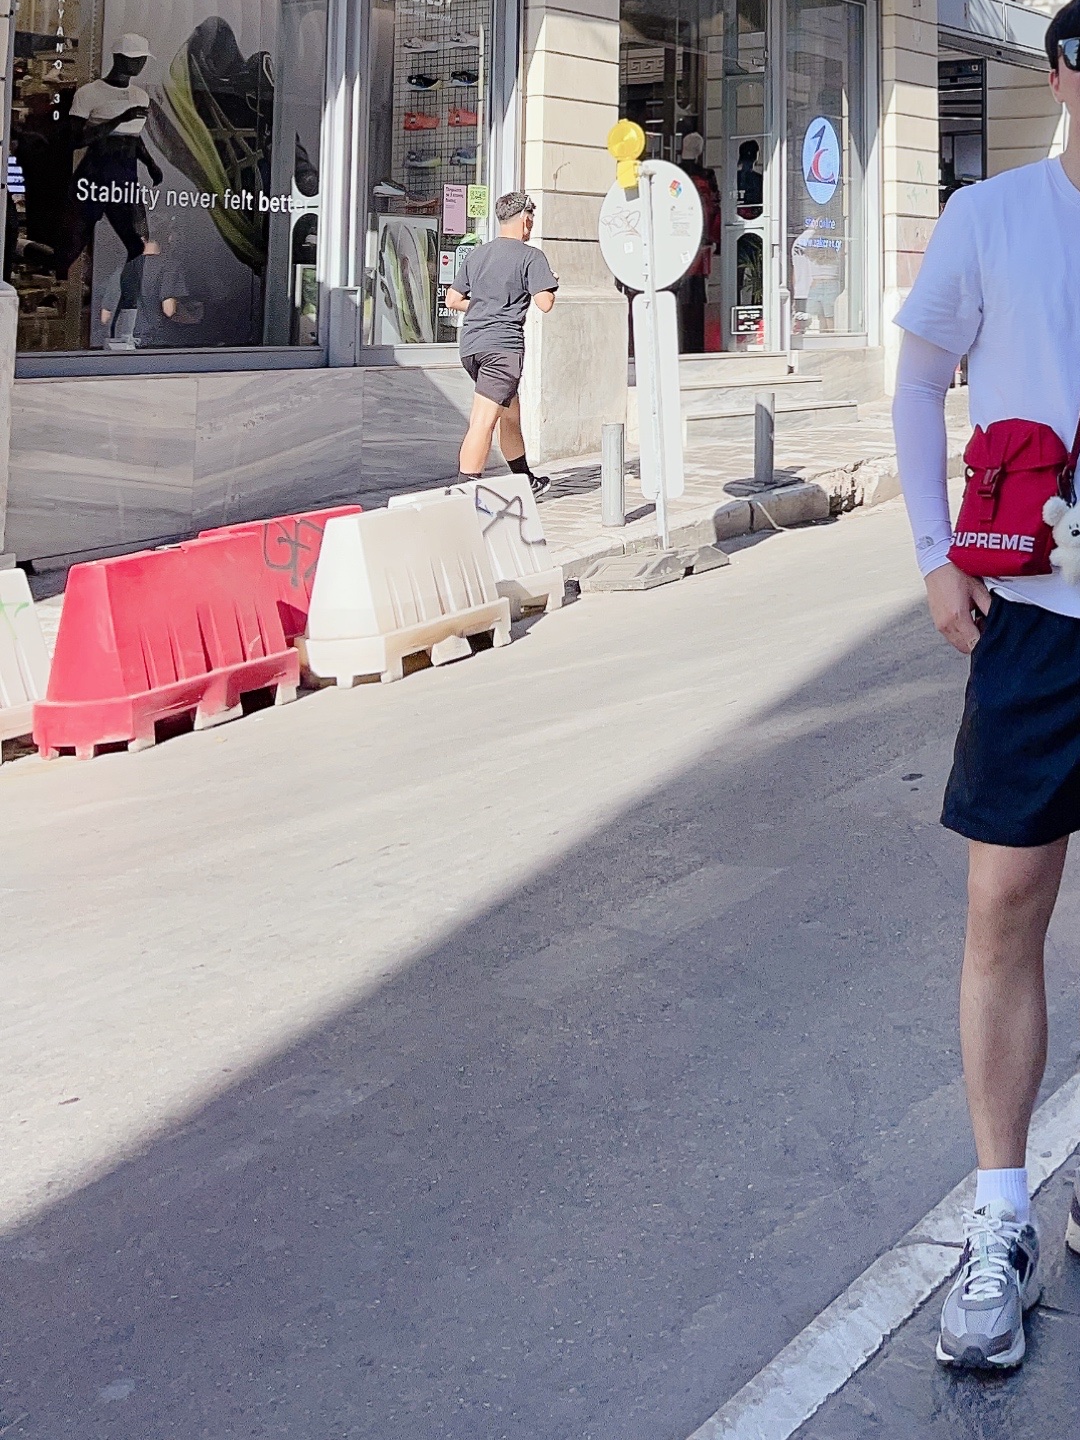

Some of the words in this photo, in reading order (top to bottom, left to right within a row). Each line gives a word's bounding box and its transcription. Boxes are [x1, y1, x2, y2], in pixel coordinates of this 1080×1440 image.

[76, 178, 160, 210] Stability
[166, 189, 218, 209] never
[223, 189, 253, 210] felt
[949, 532, 1035, 552] SUPREME
